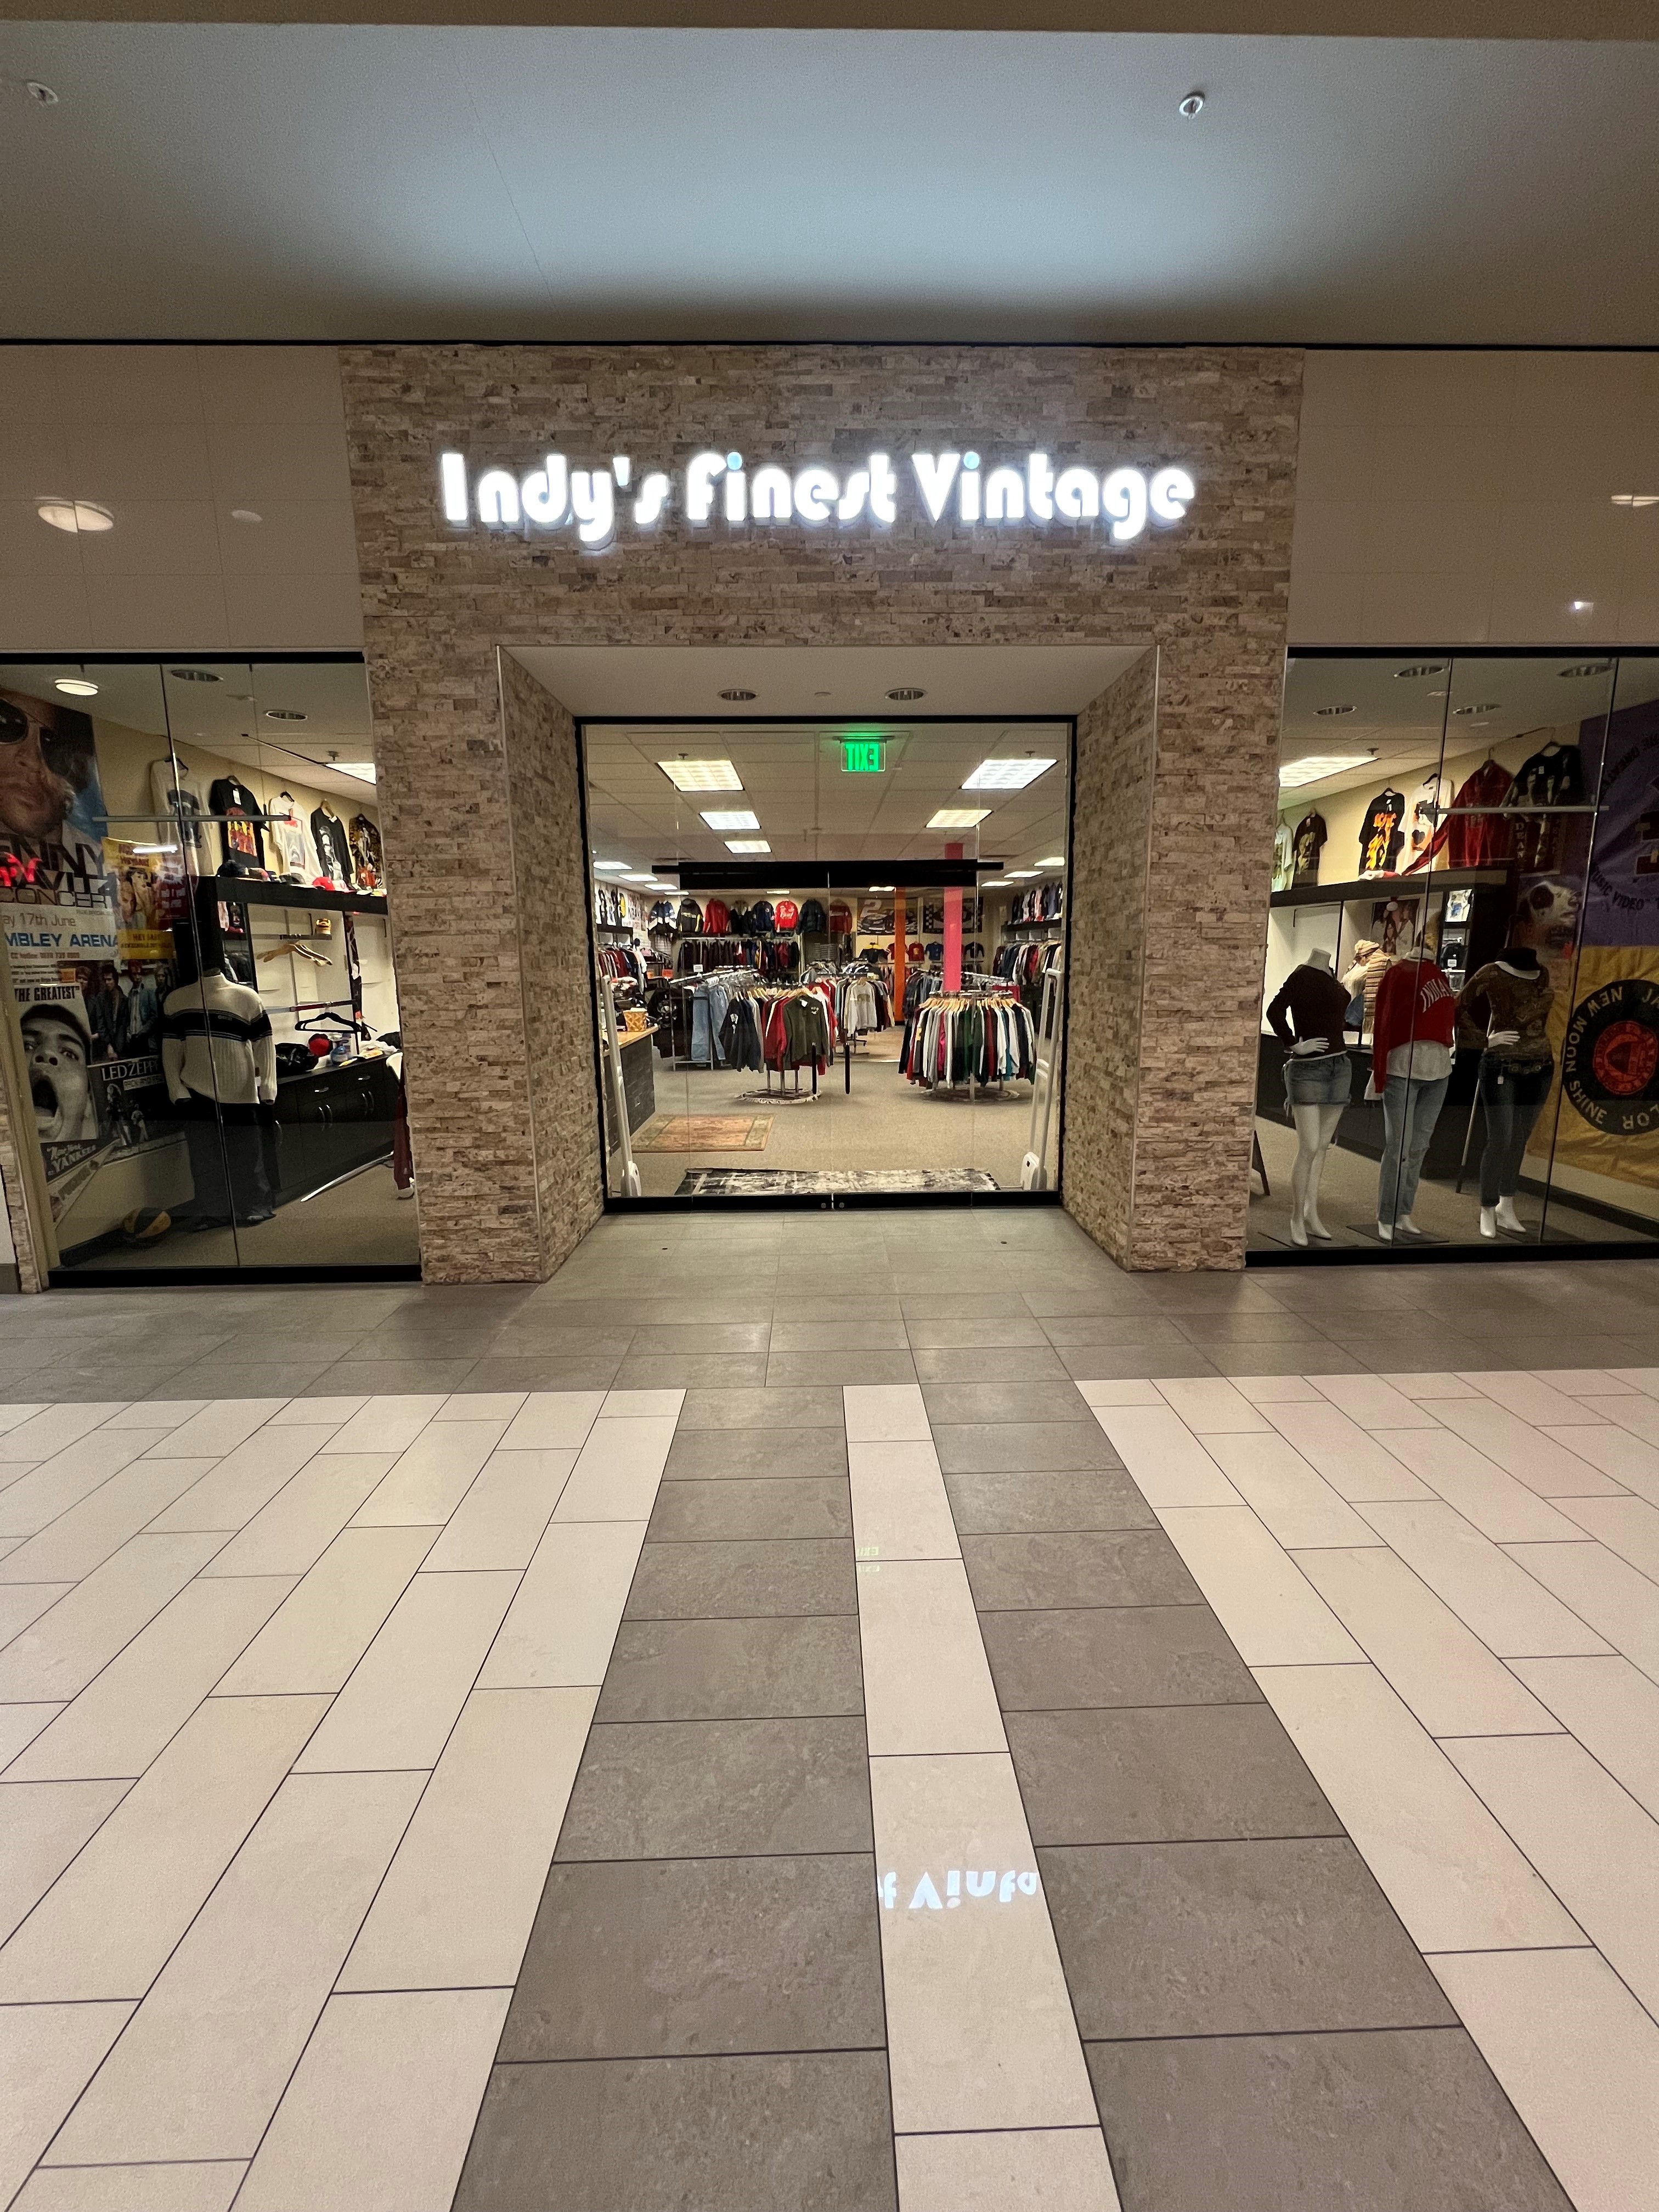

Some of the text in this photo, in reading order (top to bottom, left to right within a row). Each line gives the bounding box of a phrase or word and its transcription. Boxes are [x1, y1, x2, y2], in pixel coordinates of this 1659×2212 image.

[442, 452, 669, 543] Indy's
[911, 451, 1197, 540] Vintage
[51, 915, 77, 927] June
[100, 1064, 128, 1081] LED
[1565, 986, 1624, 1125] NEW MOON SHINE
